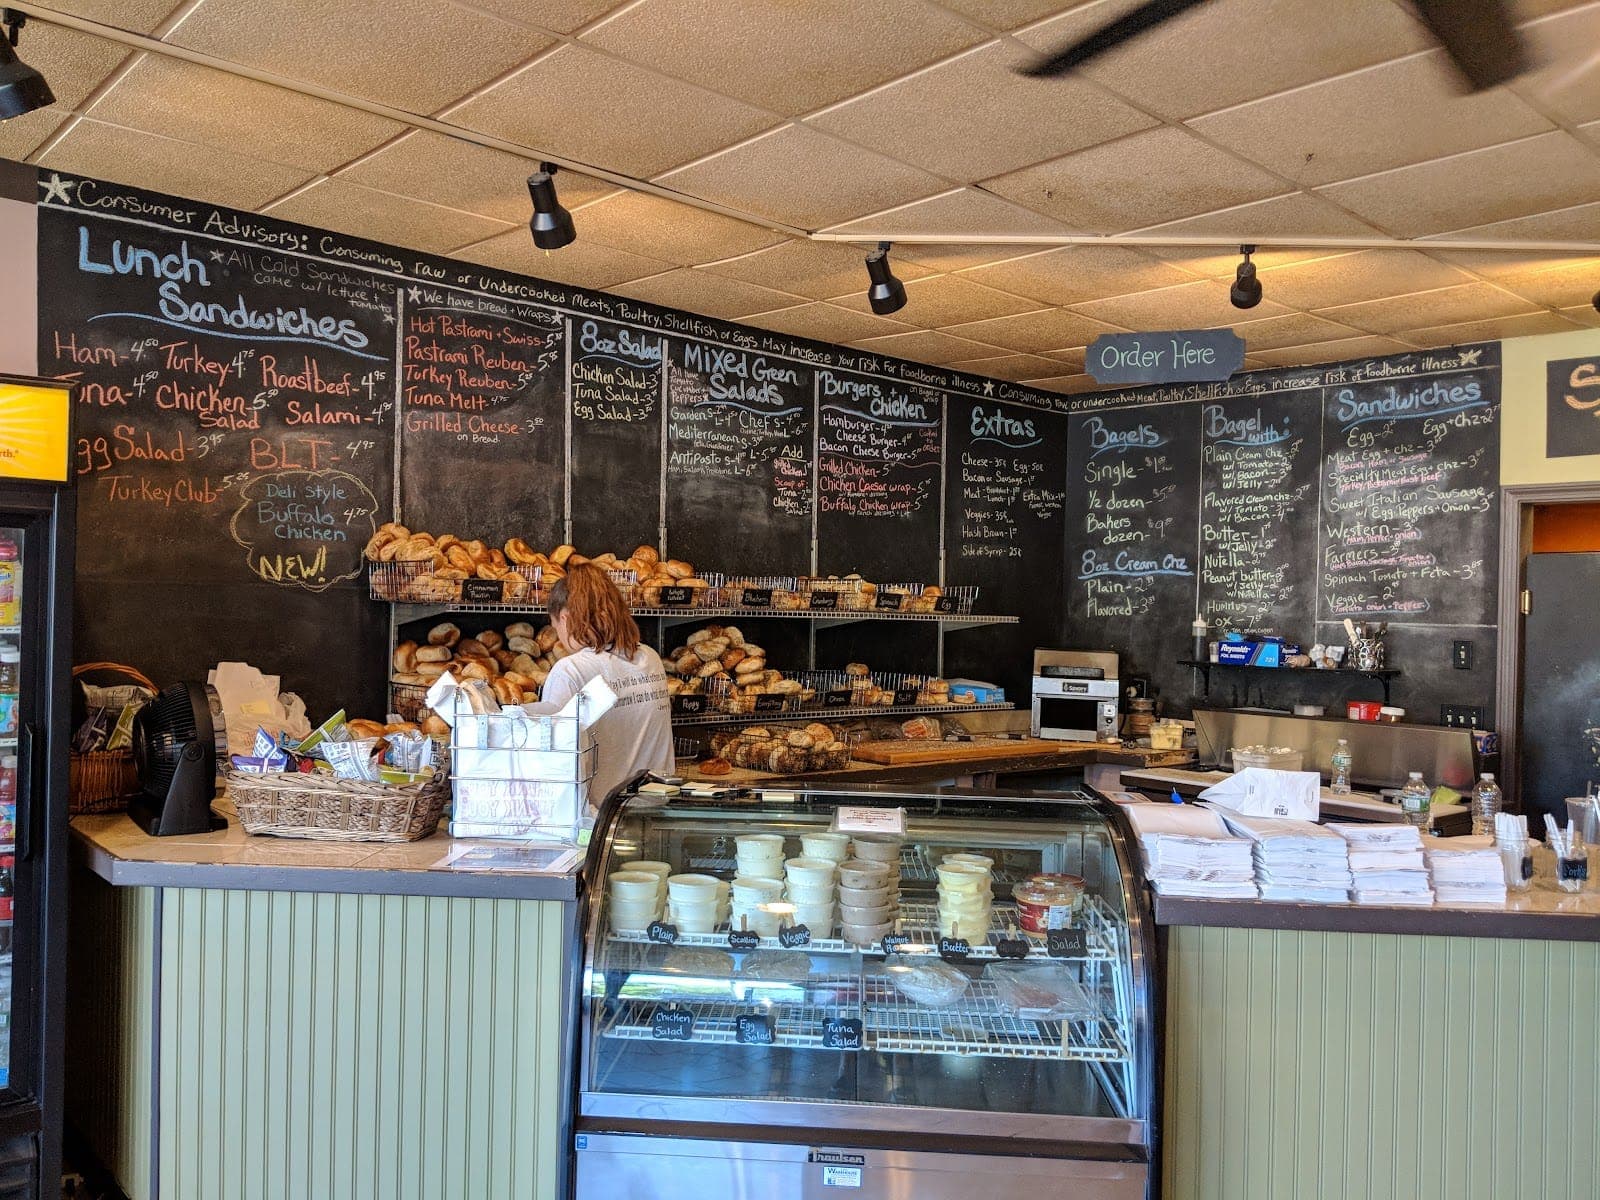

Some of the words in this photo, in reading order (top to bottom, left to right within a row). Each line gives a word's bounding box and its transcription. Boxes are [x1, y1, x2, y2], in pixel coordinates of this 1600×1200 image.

[79, 227, 211, 287] Lunch
[226, 249, 253, 273] All
[260, 256, 299, 277] Cold
[308, 263, 395, 294] Sandwiches
[77, 181, 196, 225] Consumer
[203, 210, 309, 251] Advisory:
[320, 236, 404, 273] Consuming
[415, 262, 447, 279] raw
[457, 275, 472, 284] or
[572, 293, 614, 318] Meats,
[616, 302, 663, 328] Poultry,
[720, 330, 731, 340] or
[733, 331, 758, 349] Eggs
[763, 337, 787, 355] May
[790, 341, 831, 364] increase
[859, 356, 880, 373] risk
[951, 374, 981, 393] illness
[327, 284, 368, 301] lettuce
[159, 280, 369, 348] Sandwiches
[424, 290, 443, 304] We
[447, 292, 474, 308] have
[478, 298, 508, 314] bread
[516, 307, 551, 324] Wraps
[411, 316, 436, 334] Hot
[437, 315, 493, 341] Pastrami
[405, 335, 469, 365] Pastrami
[580, 321, 618, 354] 8oz
[618, 330, 662, 360] Salad
[684, 342, 749, 379] Mixed
[751, 358, 800, 386] Green
[1101, 341, 1165, 369] Order
[1170, 339, 1216, 369] Here
[404, 364, 453, 391] Turkey
[572, 361, 614, 384] Chicken
[999, 384, 1051, 409] Consuming
[1272, 374, 1321, 391] increase
[1325, 370, 1347, 384] risk
[1352, 370, 1363, 383] of
[1422, 354, 1458, 371] illness
[405, 385, 446, 406] Tuna
[572, 383, 602, 400] Tuna
[709, 372, 784, 406] Salads
[820, 370, 881, 402] Burgers
[573, 400, 594, 420] Egg
[870, 394, 928, 420] Chicken
[1337, 382, 1482, 422] Sandwiches
[199, 407, 261, 431] Salad
[406, 410, 462, 433] Grilled
[670, 406, 707, 421] Garden
[739, 410, 771, 431] Chef
[970, 405, 1036, 438] Extras
[1203, 404, 1261, 441] Bagel
[668, 422, 741, 444] Mediterranean
[836, 429, 867, 443] Cheese
[1081, 416, 1159, 453] Bagels
[1423, 418, 1448, 437] Egg
[457, 434, 469, 442] on
[820, 437, 848, 452] Bacon
[852, 444, 880, 457] Cheese
[781, 444, 803, 459] Add
[1204, 444, 1233, 463] Plain
[1235, 446, 1261, 461] Cream
[1327, 452, 1356, 465] Meat
[1361, 450, 1381, 461] Egg
[819, 456, 843, 474] Grilled
[1381, 466, 1407, 480] Meat
[1409, 465, 1429, 476] Egg
[819, 476, 856, 492] Chicken
[859, 477, 887, 492] Caesar
[962, 468, 986, 483] Bacon
[98, 475, 173, 507] Turkey
[266, 483, 297, 499] Deli
[305, 484, 349, 505] Style
[963, 487, 981, 499] Meat
[1204, 492, 1245, 508] Flavored
[1328, 497, 1364, 513] Sweet
[1366, 490, 1418, 506] Italian
[1426, 484, 1485, 501] Sausage
[257, 501, 335, 526] Buffalo
[819, 495, 856, 512] Buffalo
[859, 499, 888, 512] Chicken
[1398, 502, 1434, 519] Peppers
[962, 524, 981, 538] Hash
[1086, 512, 1131, 533] Bakers
[1327, 521, 1390, 539] Western
[274, 524, 347, 542] Chicken
[260, 545, 328, 582] NEW!
[1082, 549, 1110, 575] 8oz
[1115, 551, 1158, 571] Cream
[1162, 553, 1188, 570] Chz
[1324, 544, 1379, 566] Farmers
[1202, 569, 1237, 583] Peanut
[1324, 571, 1367, 588] Spinach
[1369, 568, 1407, 582] Tomato
[1325, 593, 1366, 608] Veggie
[652, 926, 674, 944] Plain
[781, 929, 811, 946] Veggie
[1051, 935, 1080, 951] Salad
[656, 1012, 691, 1024] Chicken
[739, 1019, 755, 1033] Egg
[654, 1026, 684, 1038] Salad
[743, 1029, 773, 1042] Salad
[825, 1023, 854, 1035] Tuna
[830, 1033, 859, 1047] Salad
